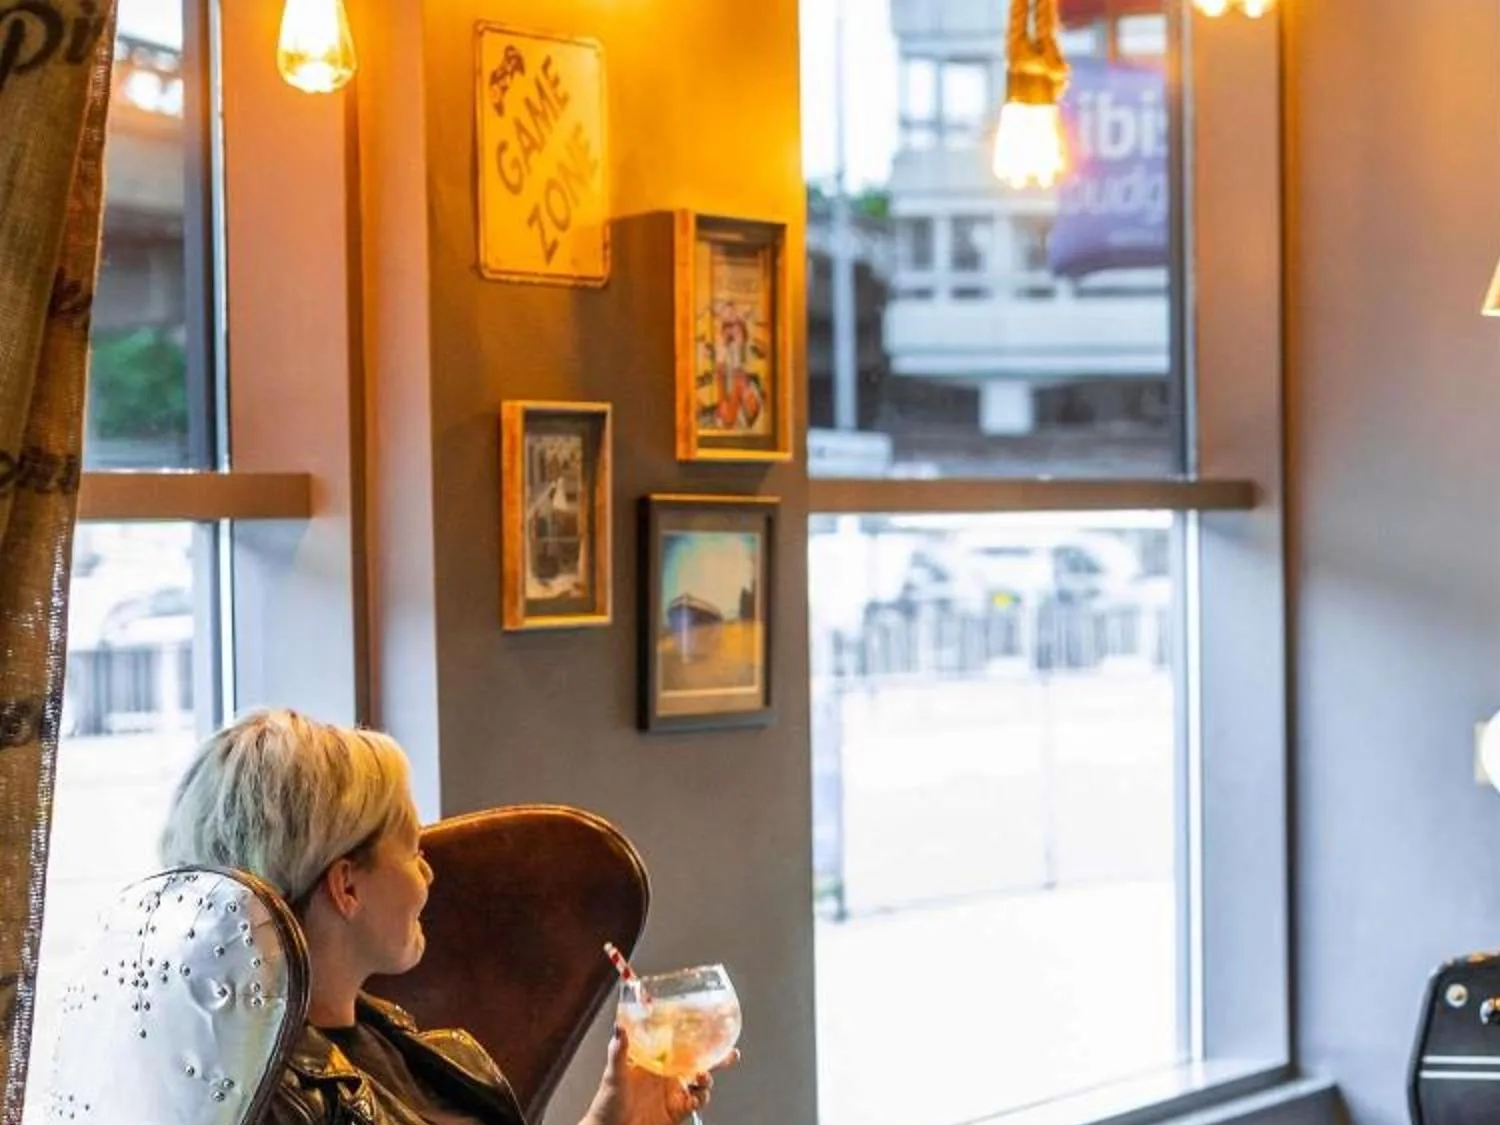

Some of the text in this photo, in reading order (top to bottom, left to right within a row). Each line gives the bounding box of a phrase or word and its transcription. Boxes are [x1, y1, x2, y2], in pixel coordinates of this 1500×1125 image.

[495, 54, 570, 195] GAME
[526, 121, 598, 266] ZONE
[1077, 91, 1168, 160] ibi
